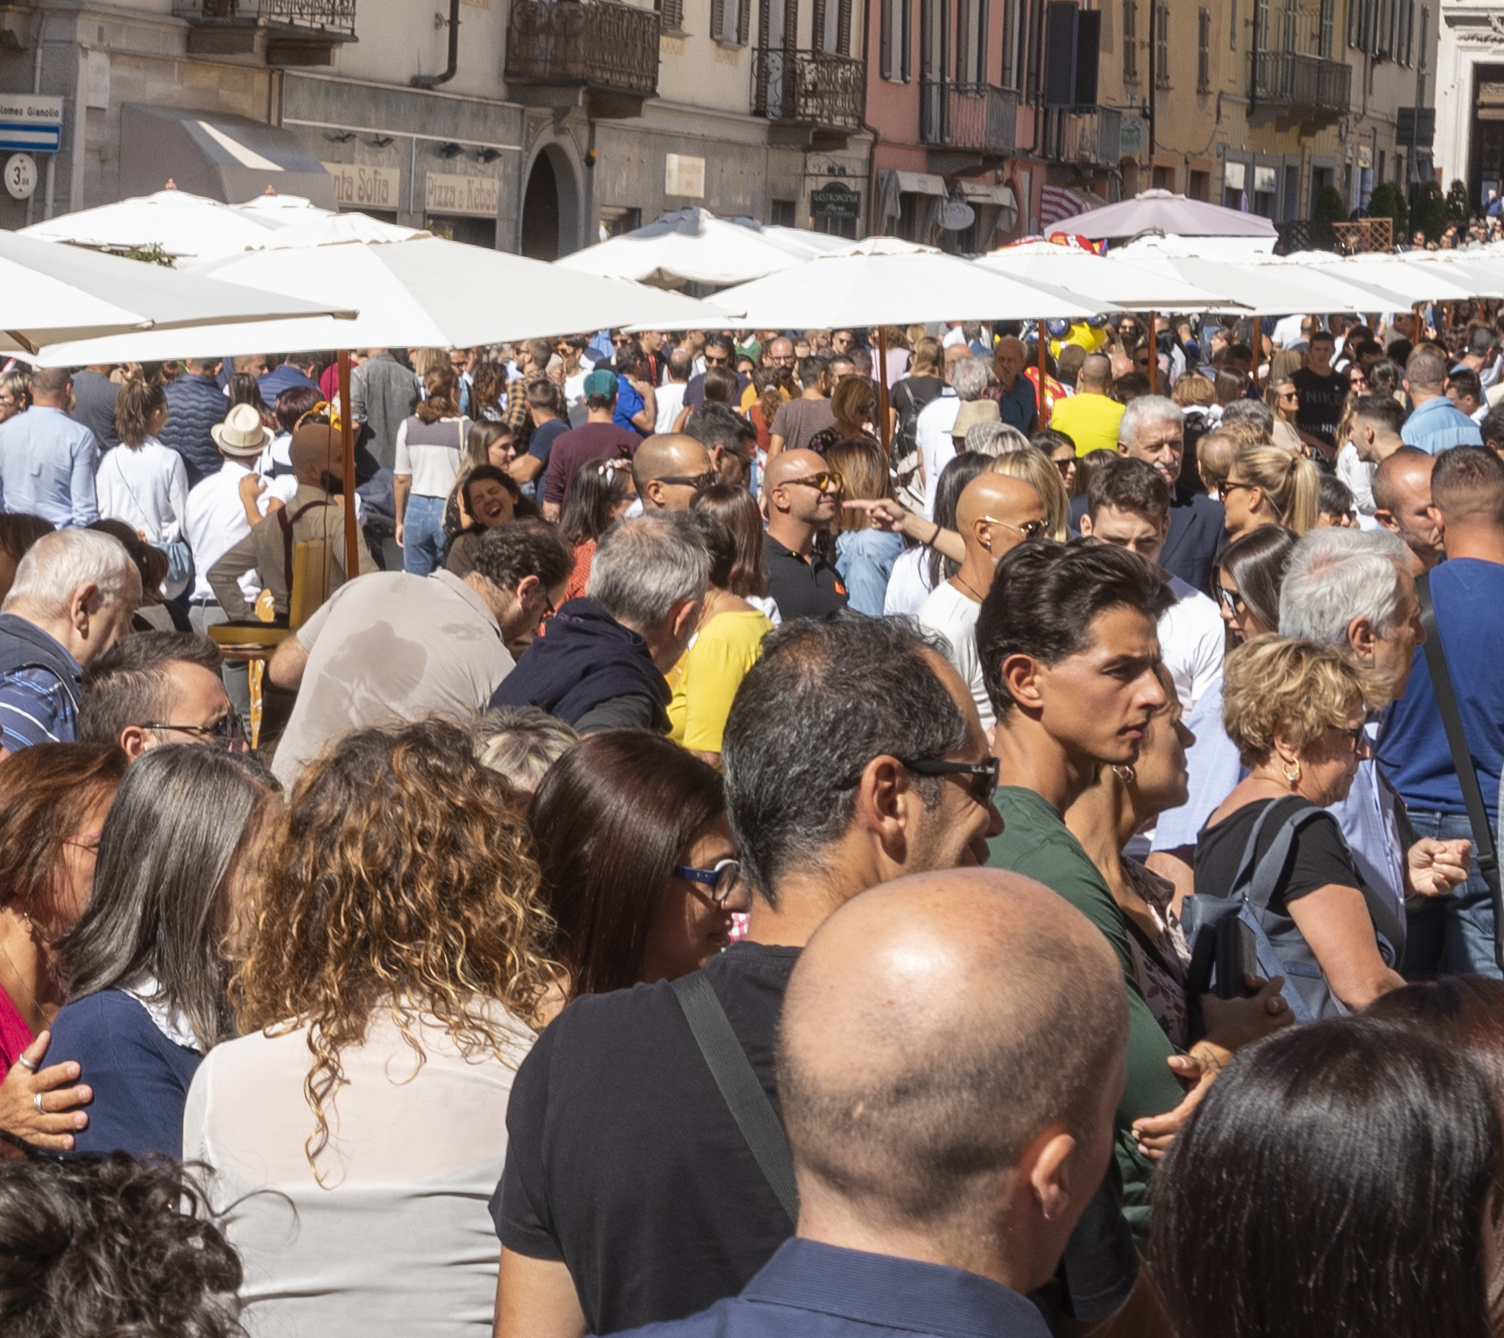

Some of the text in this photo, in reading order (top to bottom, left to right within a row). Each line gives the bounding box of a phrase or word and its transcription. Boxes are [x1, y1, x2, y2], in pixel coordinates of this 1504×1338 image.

[357, 166, 389, 203] Sofia
[425, 177, 456, 209] Pizza
[466, 179, 498, 210] Kebab
